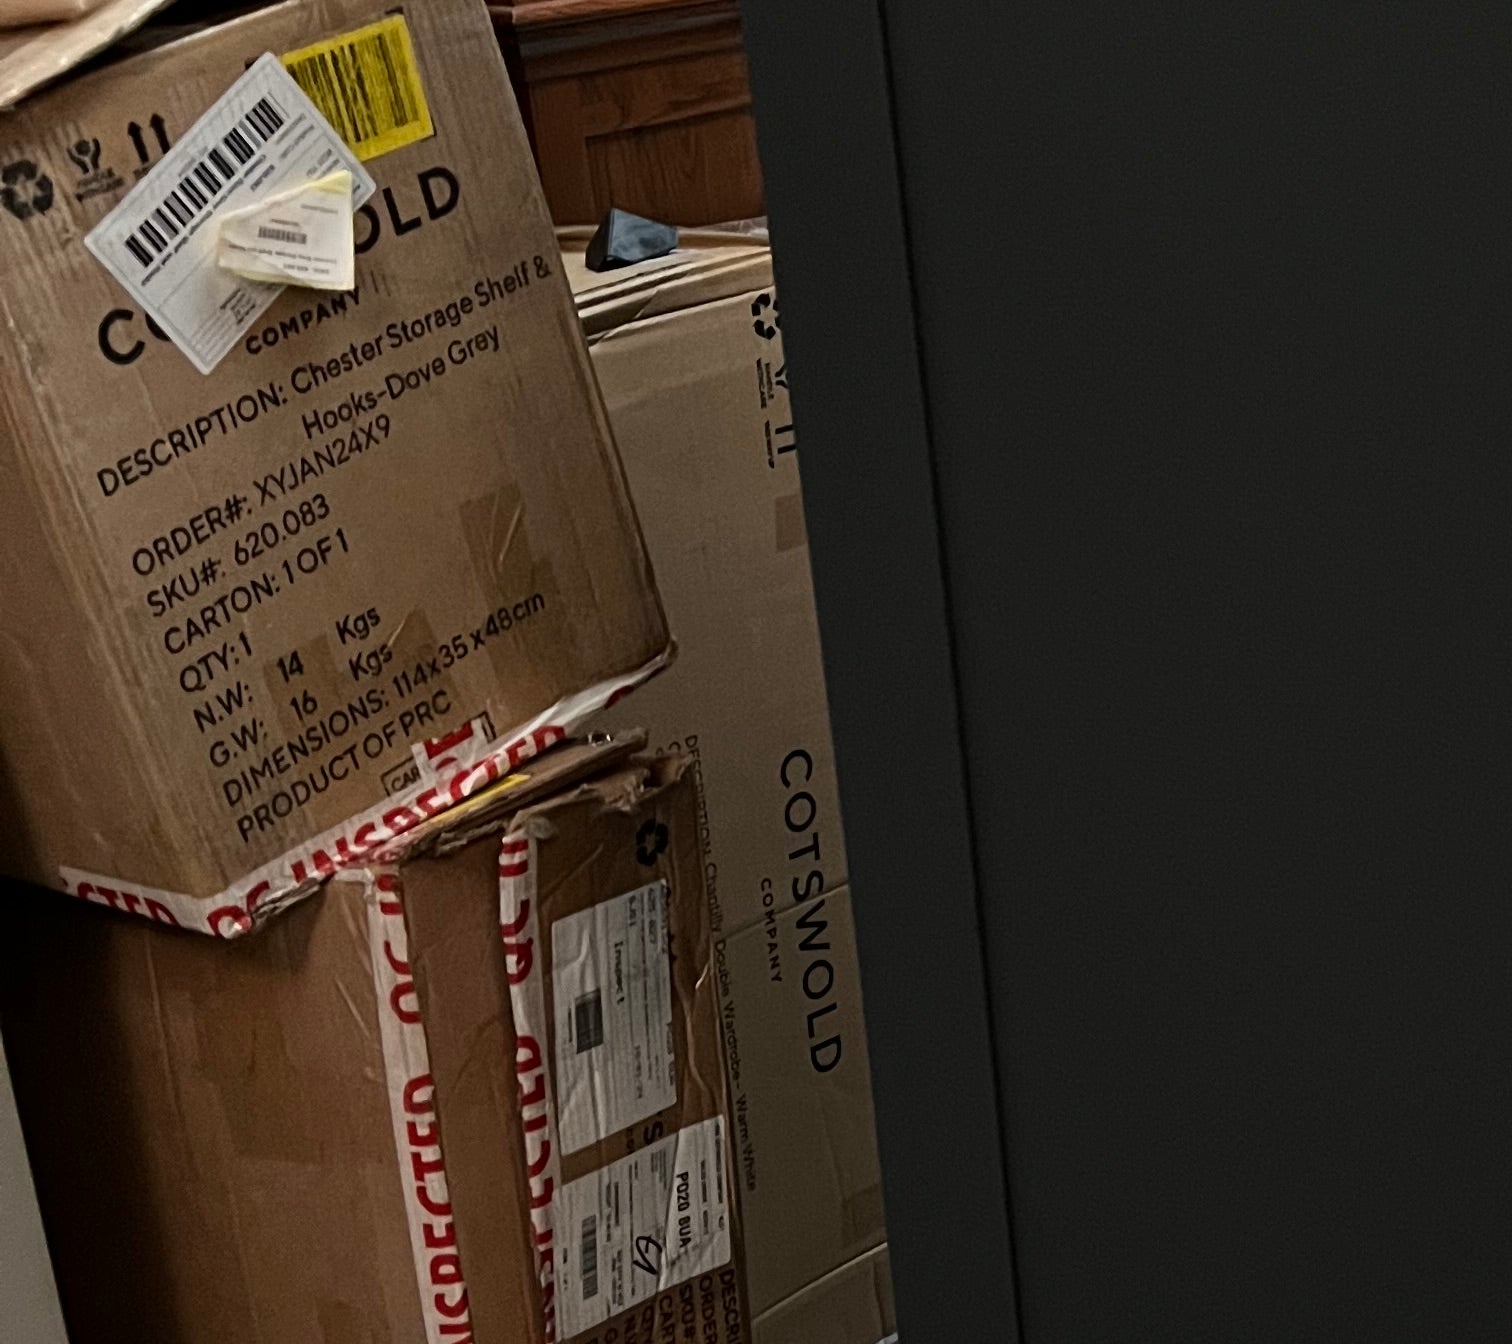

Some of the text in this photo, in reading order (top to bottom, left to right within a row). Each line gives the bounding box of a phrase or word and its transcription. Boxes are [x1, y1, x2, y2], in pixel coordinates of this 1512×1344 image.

[96, 254, 552, 497] DESCRIPTION: Chester Storage Shelf &
[245, 286, 362, 356] COMPANY
[301, 324, 501, 440] Hooks-Dove Grey
[131, 412, 392, 578] ORDER#: XYJAN24X9
[147, 492, 331, 618] SKU#: 620.083
[163, 573, 281, 655] CARTON:
[295, 535, 334, 575] OF
[192, 605, 382, 734] N.W: 14 Kgs
[208, 642, 394, 769] G.W: 16 Kgs
[222, 690, 390, 808] DIMENSIONS:
[236, 746, 362, 843] PRODUCT
[362, 726, 398, 759] OF
[398, 689, 452, 734] PRC
[704, 862, 724, 934] Chantilly
[760, 877, 783, 984] COMPANY
[779, 749, 843, 1074] COTSWOLD
[713, 939, 731, 997] Double
[736, 1093, 750, 1144] Warm
[742, 1143, 758, 1192] White
